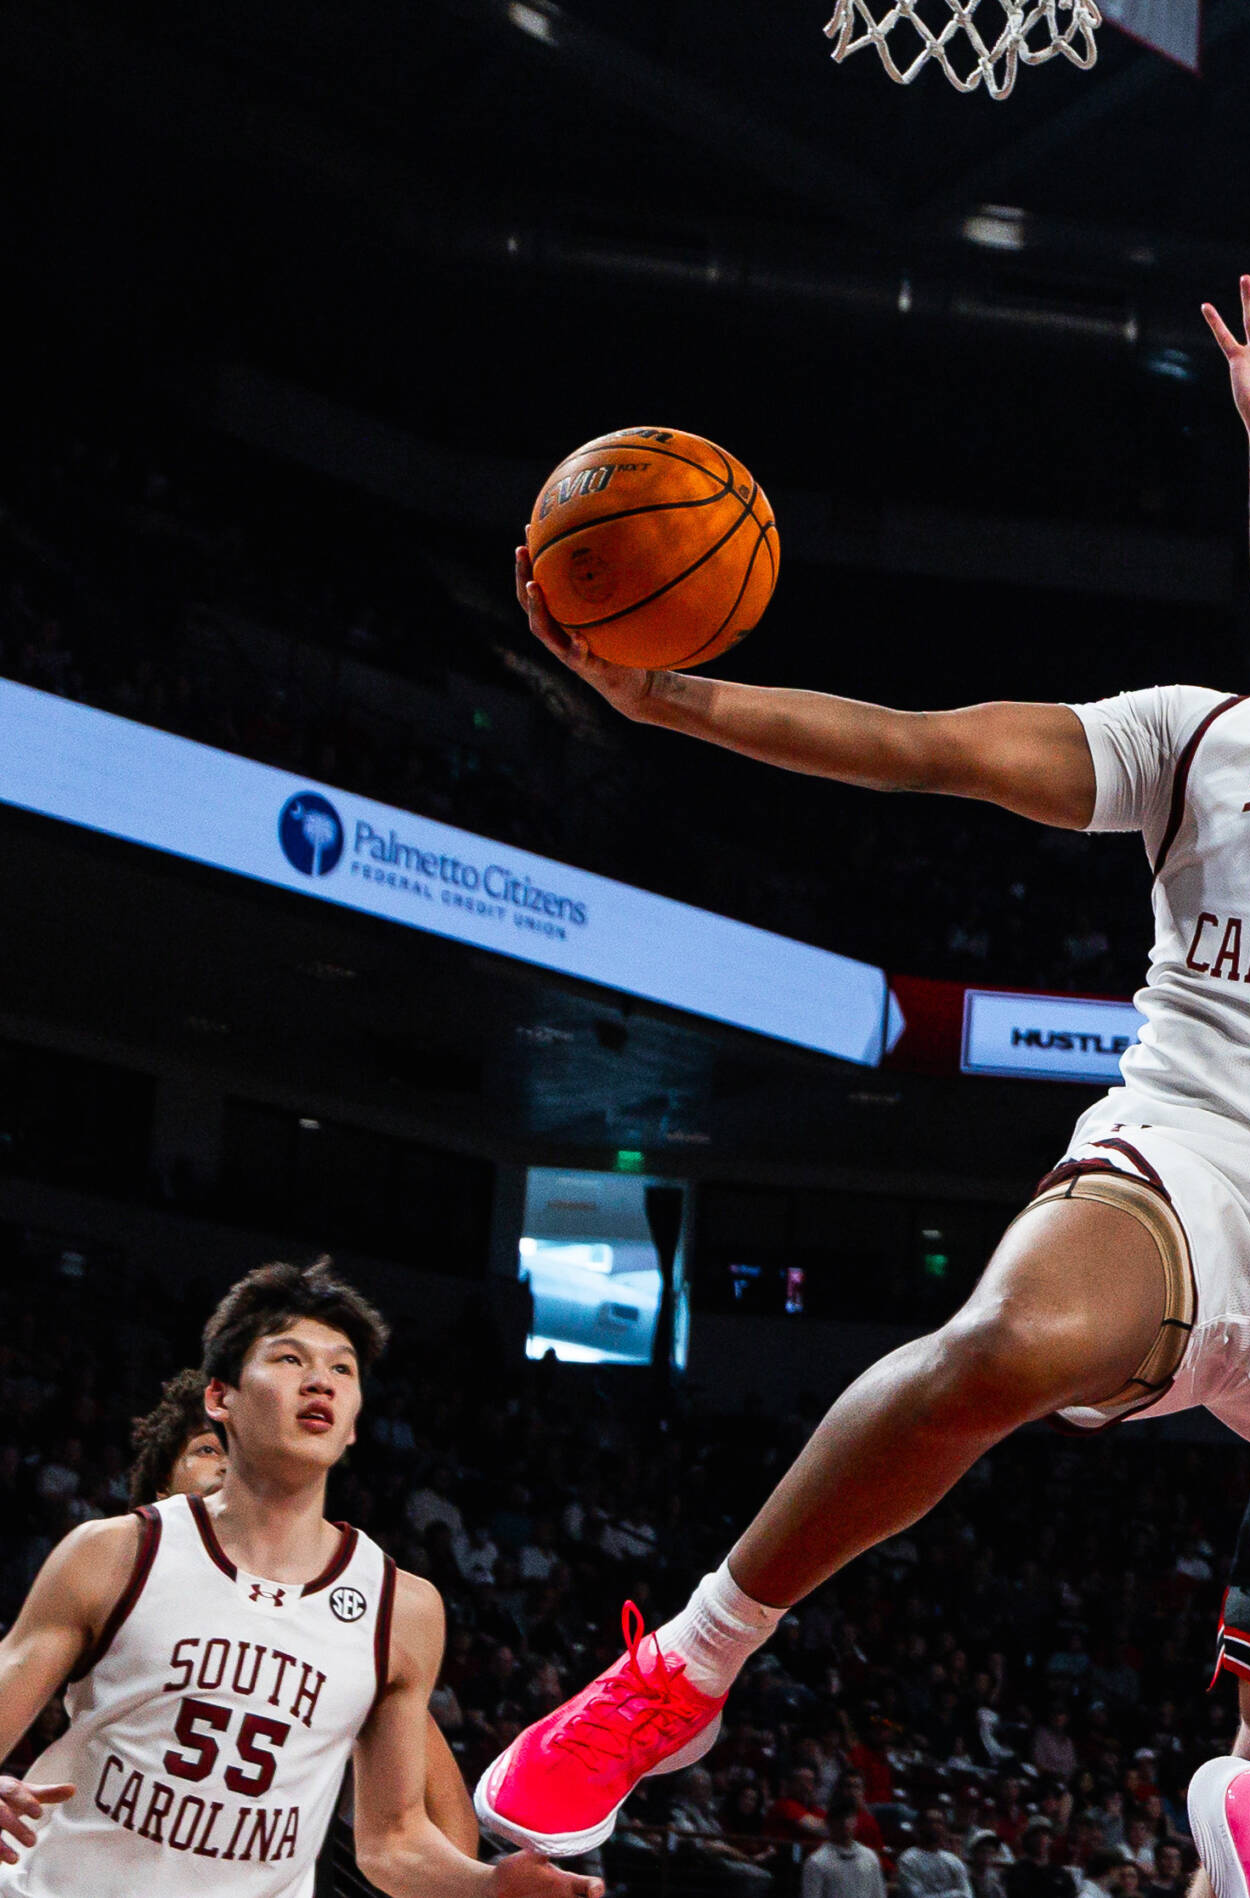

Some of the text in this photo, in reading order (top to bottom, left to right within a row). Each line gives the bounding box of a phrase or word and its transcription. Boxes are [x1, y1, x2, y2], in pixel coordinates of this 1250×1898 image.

[351, 860, 568, 941] FEDERAL CREDIT UNION
[354, 819, 588, 926] Palmetto Citizens
[1012, 1026, 1130, 1054] HUSTLE
[331, 1588, 366, 1621] SEC
[162, 1638, 327, 1728] SOUTH
[162, 1697, 292, 1798] 55
[94, 1754, 300, 1862] CAROLINA
